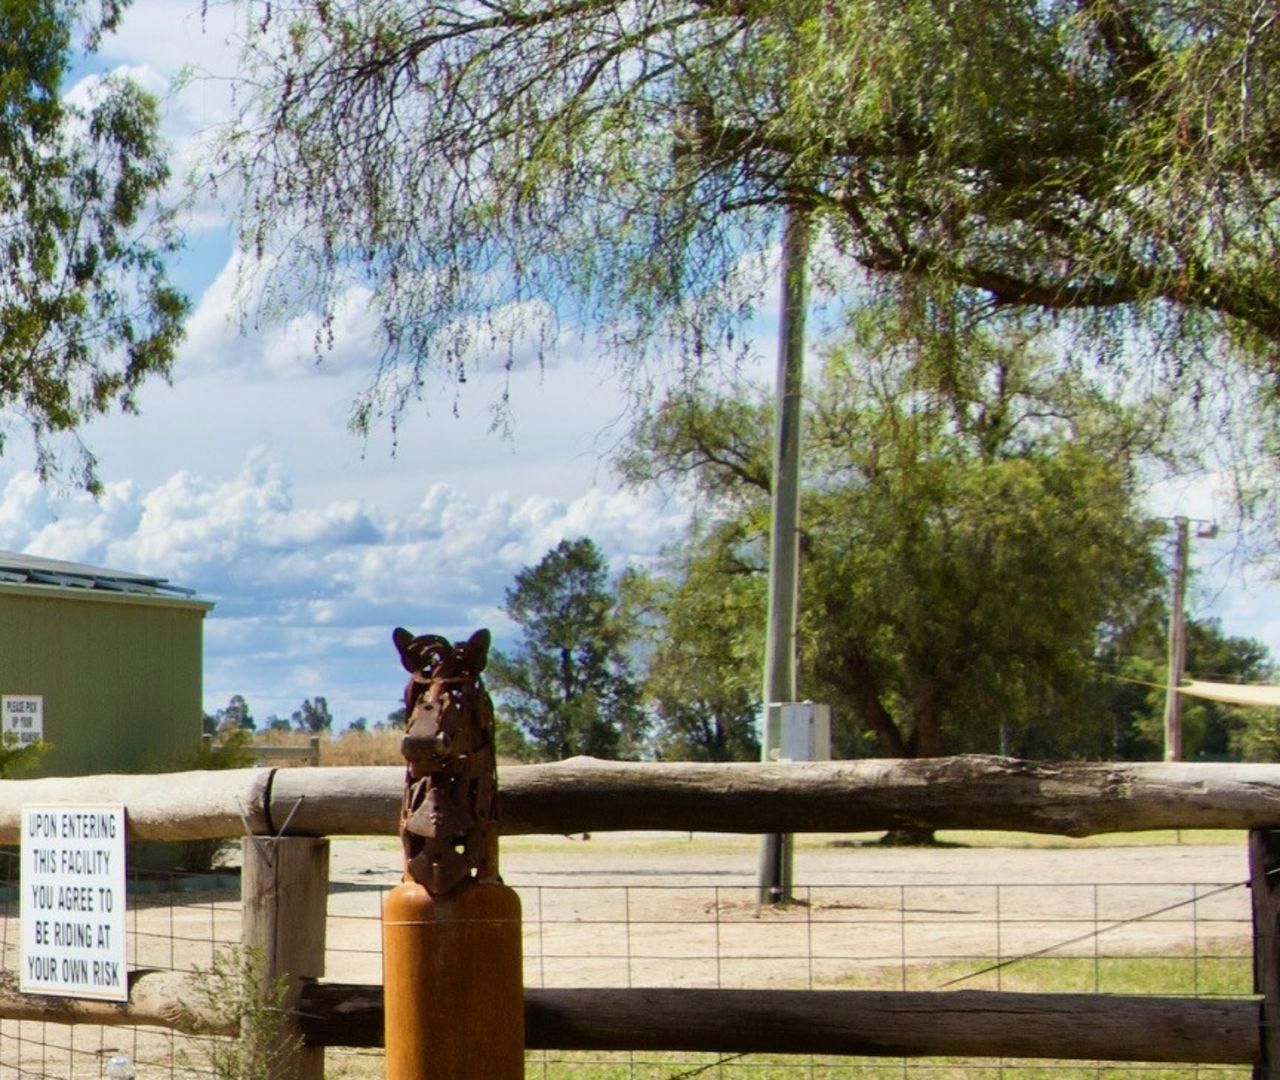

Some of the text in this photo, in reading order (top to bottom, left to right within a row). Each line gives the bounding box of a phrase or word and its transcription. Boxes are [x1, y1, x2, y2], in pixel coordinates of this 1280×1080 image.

[30, 814, 115, 838] UPON ENTERING
[34, 849, 109, 874] THIS FACILITY
[33, 886, 112, 912] YOU AGREE TO
[36, 921, 110, 948] BE RIDING AT
[29, 957, 118, 986] YOUR OWN RISK
